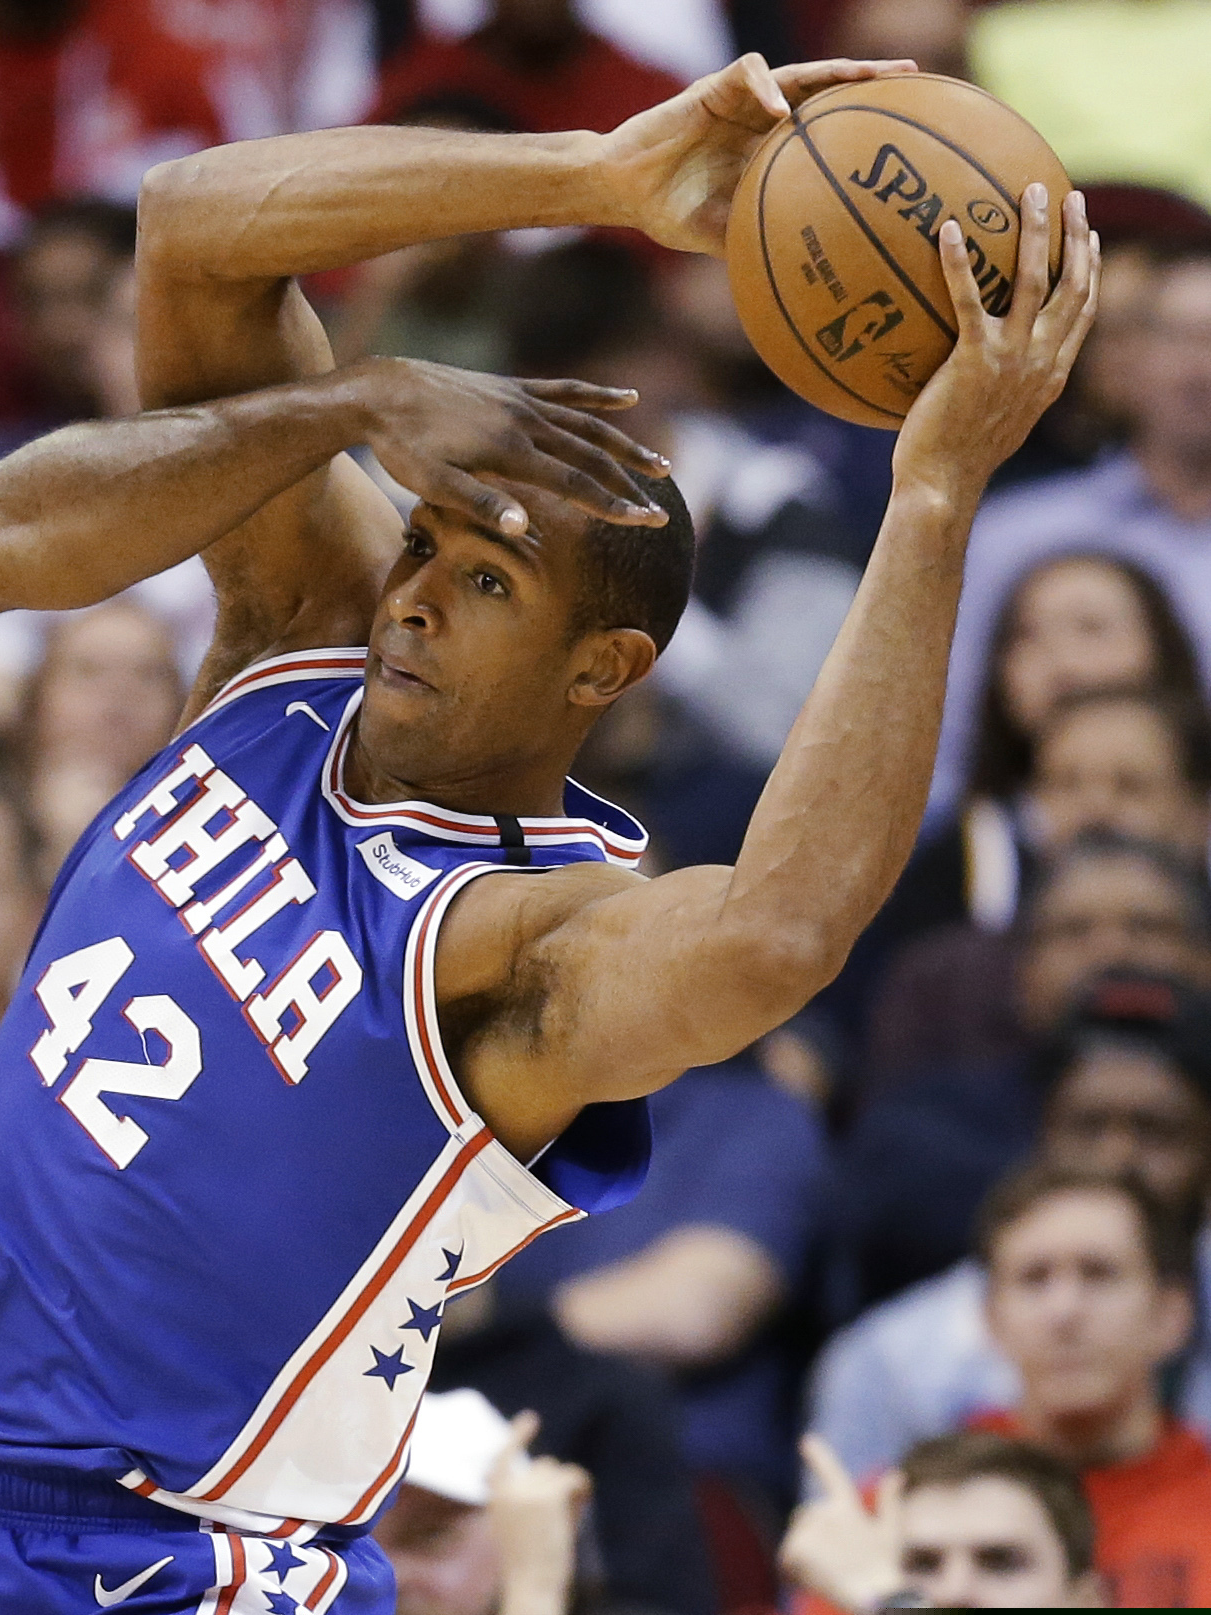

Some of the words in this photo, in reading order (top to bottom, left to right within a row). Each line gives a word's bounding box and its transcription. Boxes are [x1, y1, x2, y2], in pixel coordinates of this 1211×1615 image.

[848, 143, 1012, 317] SPADIN
[372, 844, 421, 888] StubHub
[27, 936, 203, 1171] 42
